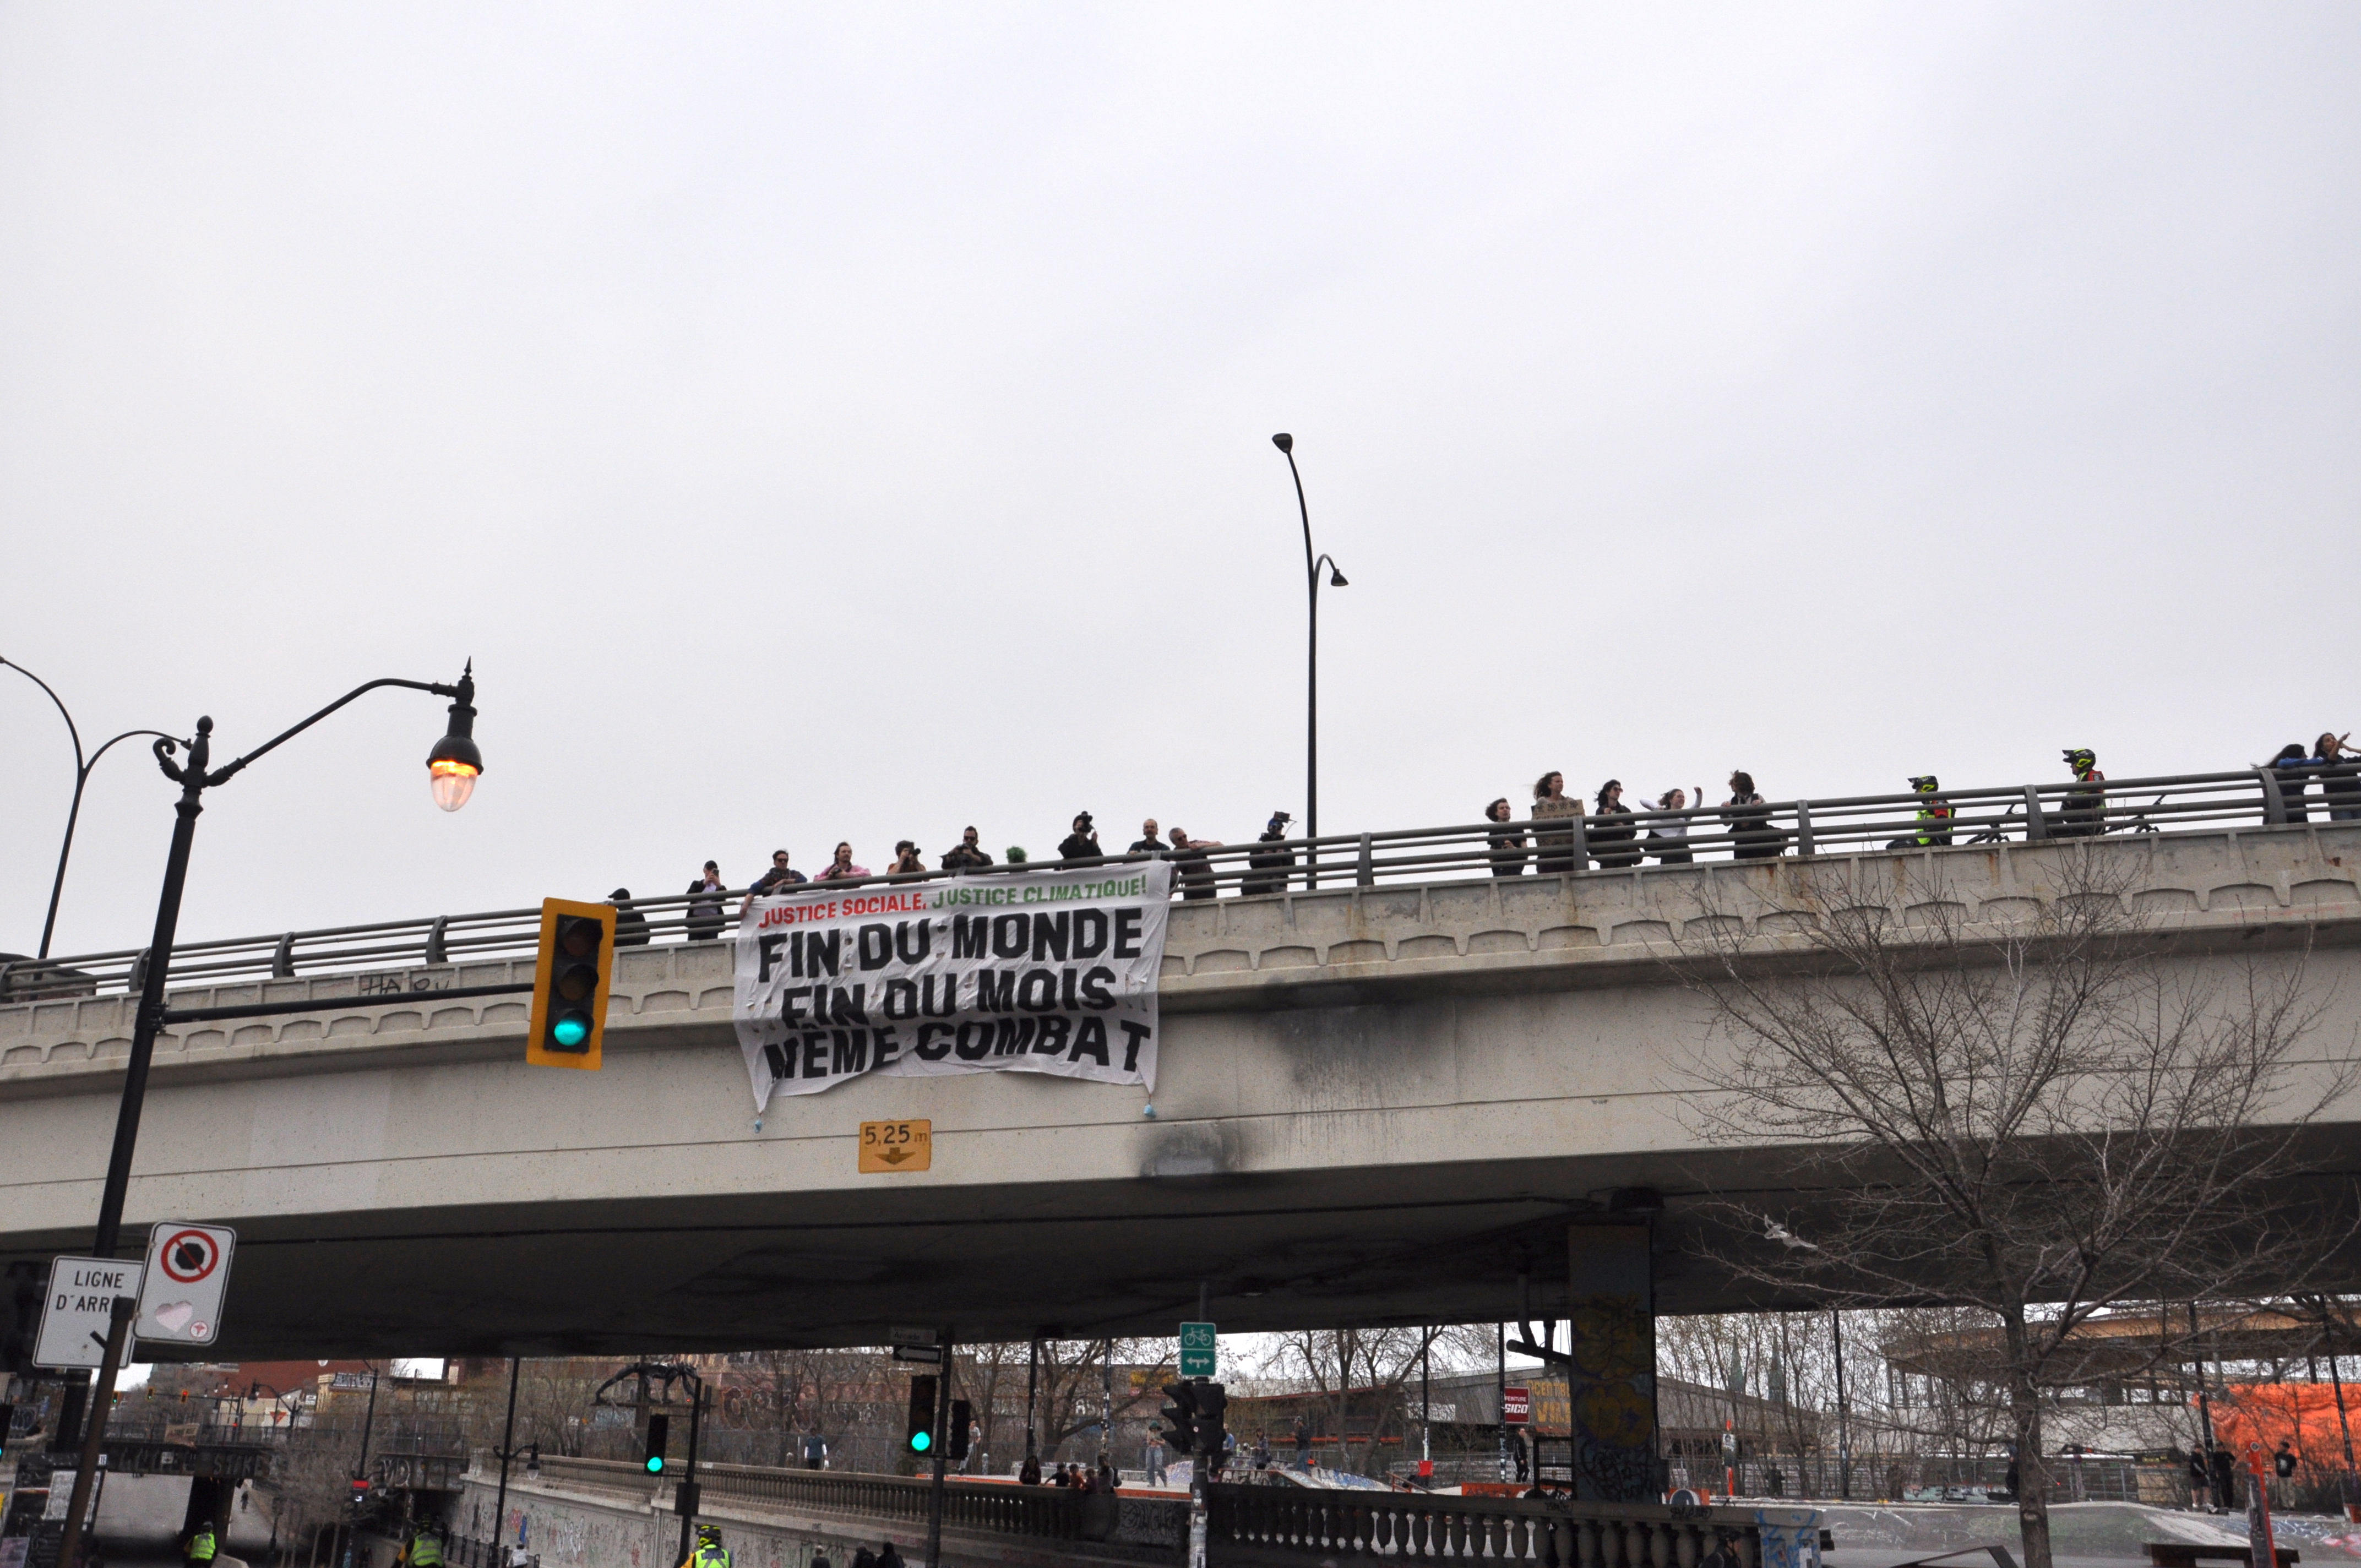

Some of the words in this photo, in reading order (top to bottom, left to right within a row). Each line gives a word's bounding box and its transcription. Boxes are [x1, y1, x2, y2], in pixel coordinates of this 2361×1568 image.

[758, 902, 836, 928] JUSTICE
[842, 892, 927, 916] SOCIALE,
[932, 888, 1016, 908] JUSTICE
[1023, 874, 1147, 903] CLIMATIQUE!
[758, 928, 840, 983] FIN
[858, 918, 932, 971] DU
[951, 908, 1142, 961] MONDE
[782, 983, 870, 1029] FIN
[883, 973, 957, 1020] DU
[977, 966, 1117, 1012] MOIS
[915, 1015, 1151, 1072] COMBAT
[865, 1124, 910, 1146] 5,25
[914, 1133, 927, 1142] m
[74, 1271, 124, 1288] LIGNE
[56, 1294, 110, 1313] D'ARR
[1505, 1403, 1528, 1414] SICO
